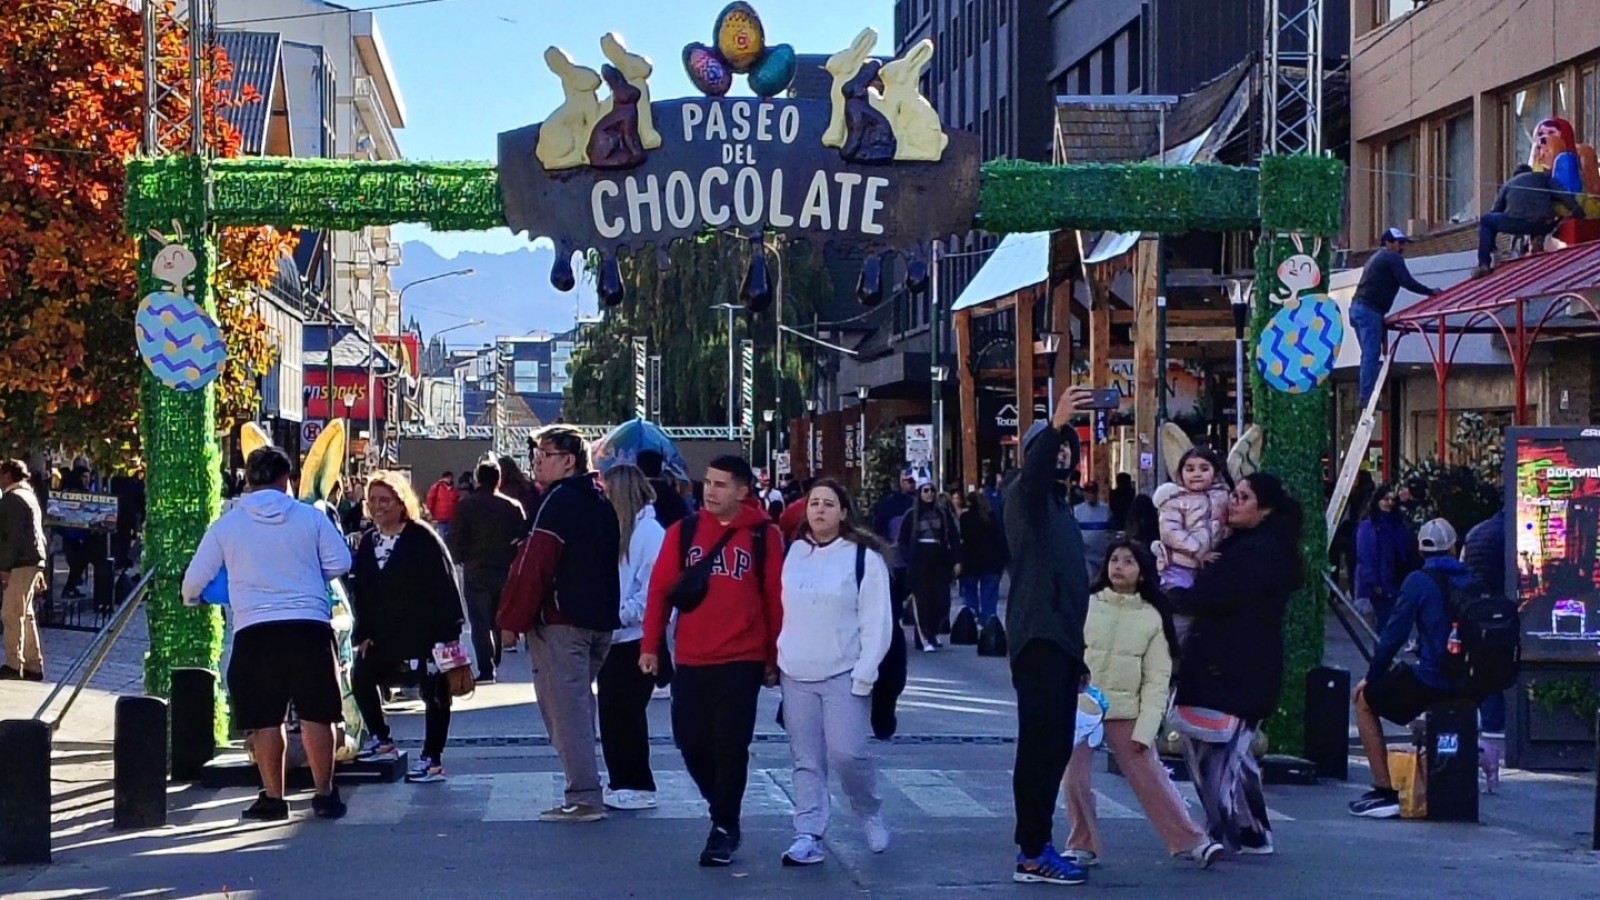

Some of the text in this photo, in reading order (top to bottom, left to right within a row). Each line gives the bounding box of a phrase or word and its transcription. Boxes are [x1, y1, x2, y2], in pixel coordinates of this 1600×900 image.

[681, 101, 800, 143] PASEO
[721, 143, 756, 165] DEL
[591, 166, 889, 238] CHOCOLATE
[685, 546, 752, 580] GAP
